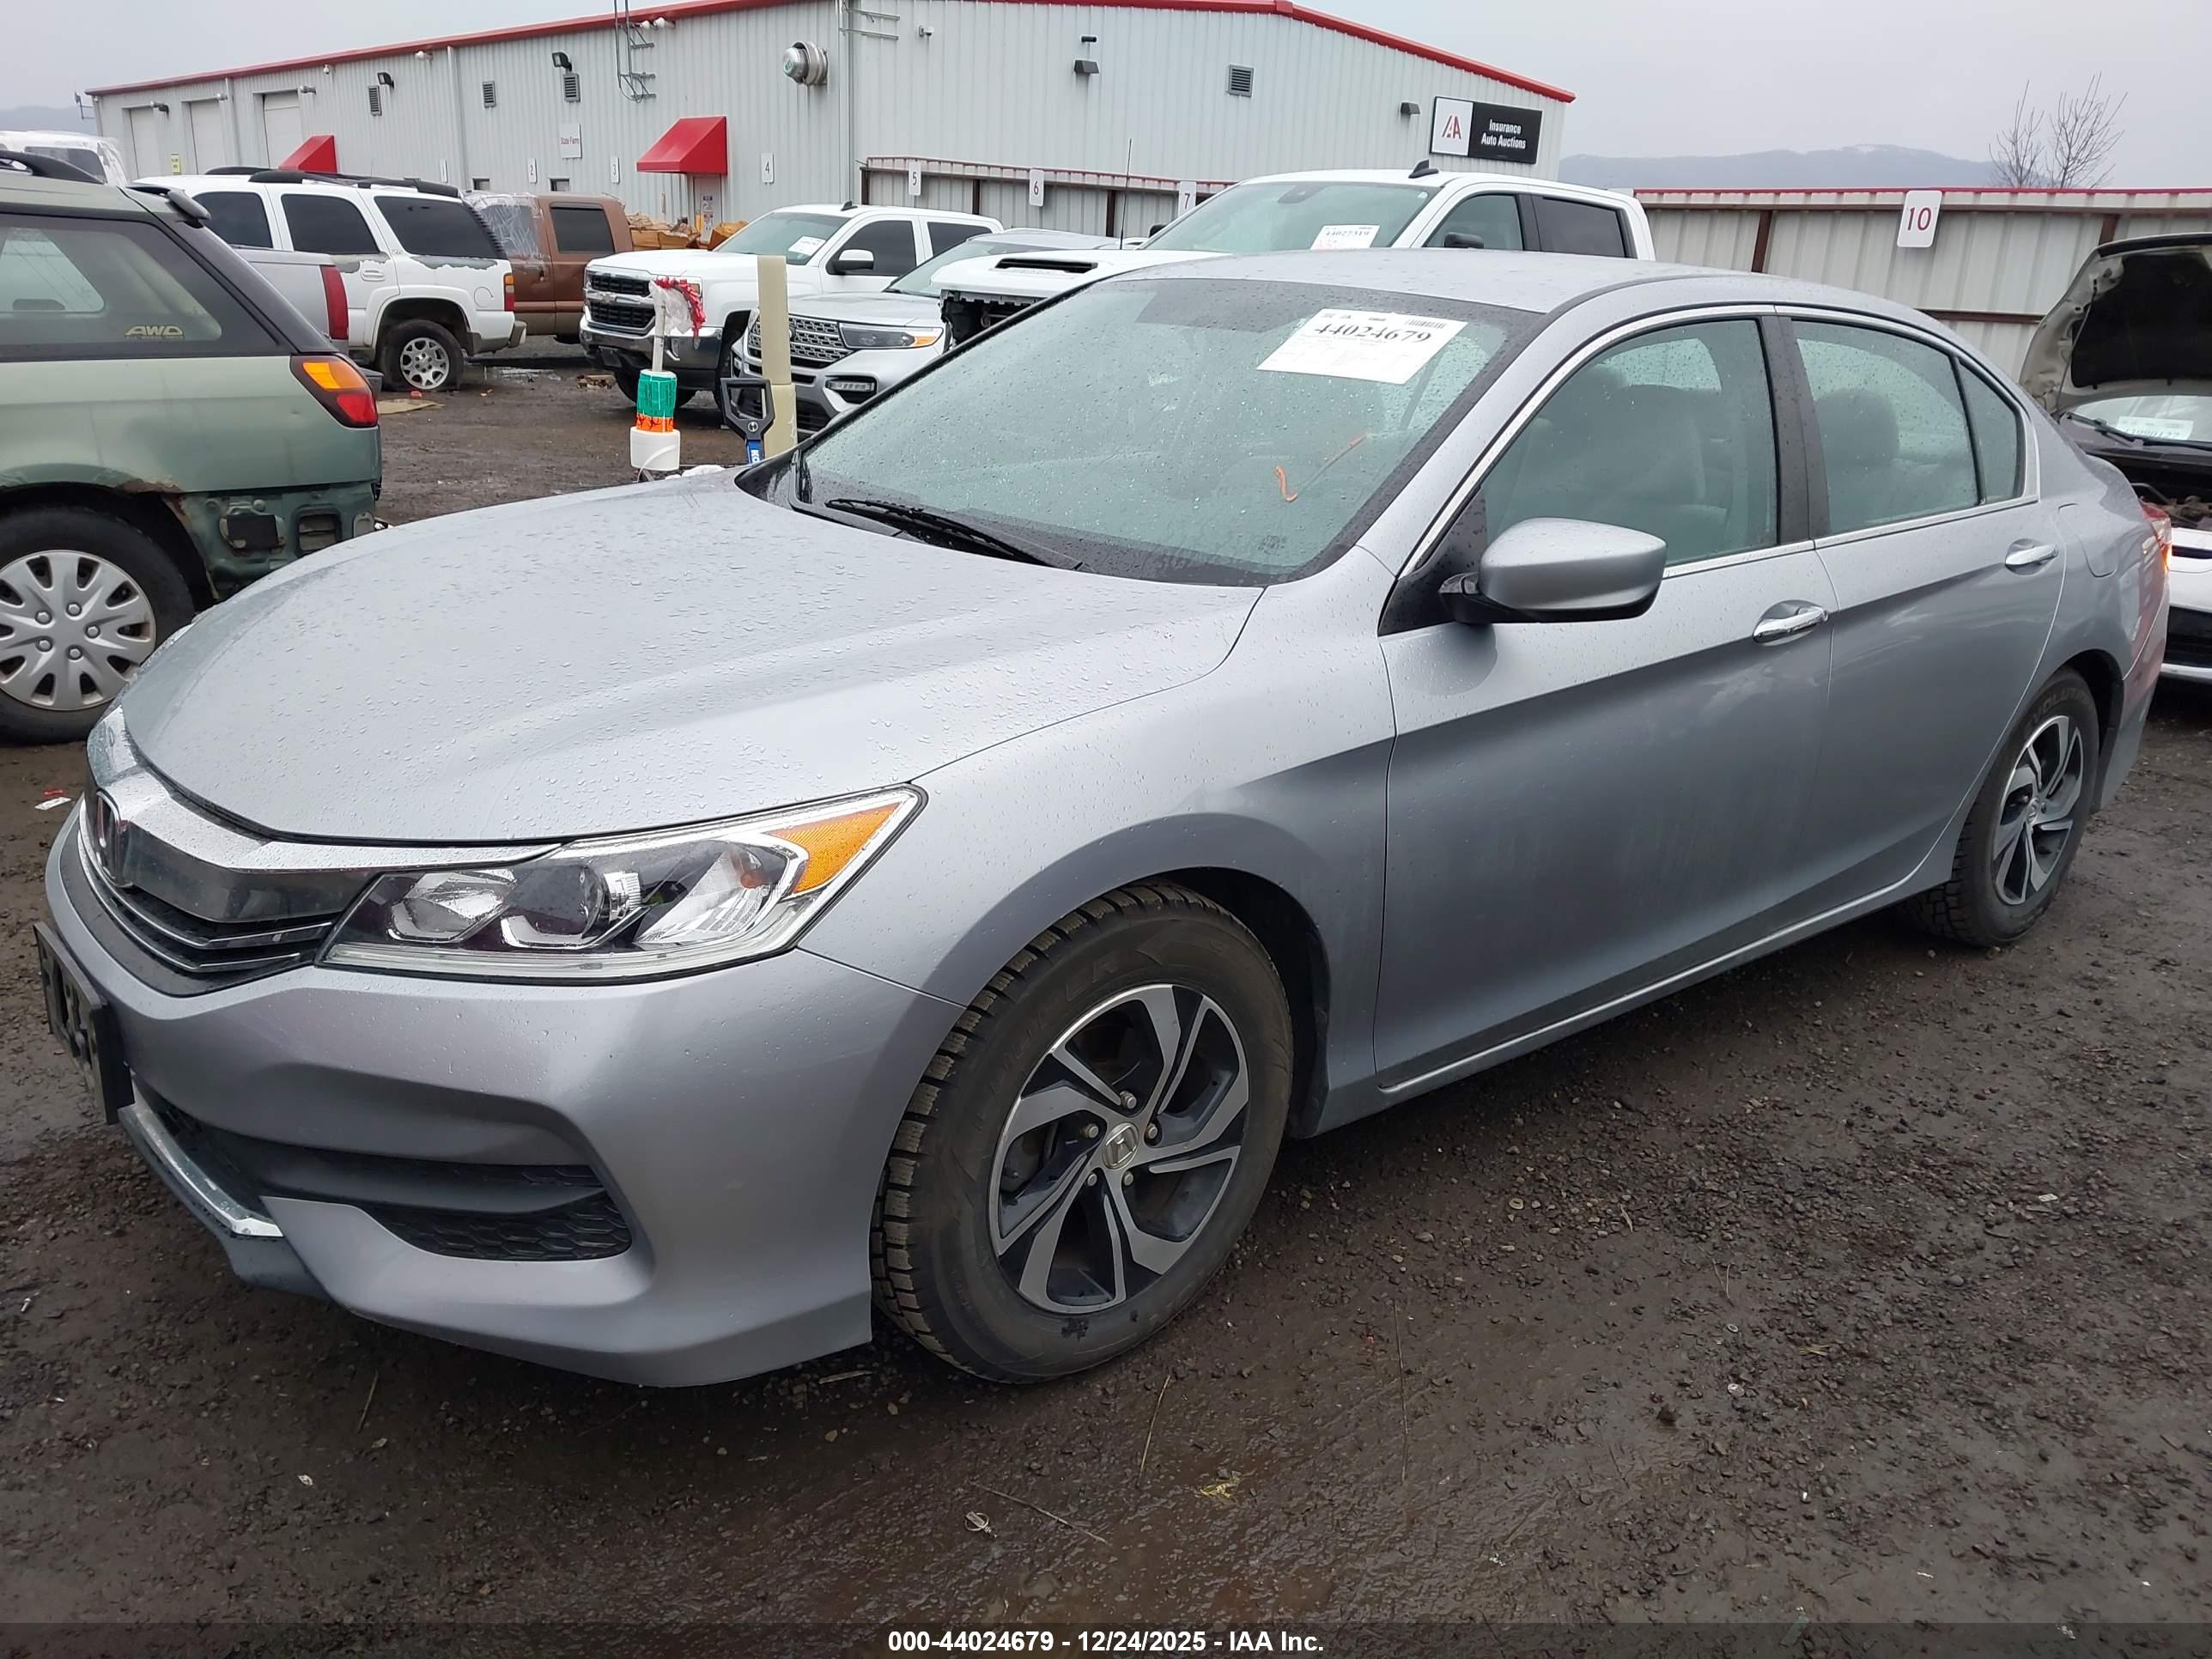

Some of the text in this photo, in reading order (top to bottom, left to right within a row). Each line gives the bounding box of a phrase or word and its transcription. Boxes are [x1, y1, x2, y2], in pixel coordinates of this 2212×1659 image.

[1489, 118, 1522, 135] Insurance
[560, 136, 580, 145] State Farm
[1480, 132, 1527, 149] Auto Auctions
[530, 164, 534, 176] 2
[612, 164, 617, 175] 3
[764, 161, 770, 174] 4
[912, 171, 918, 185] 5
[1033, 180, 1039, 196] 6
[1184, 192, 1191, 209] 7
[1907, 206, 1933, 231] 10
[124, 325, 184, 336] AWD
[1315, 323, 1431, 343] 44024679
